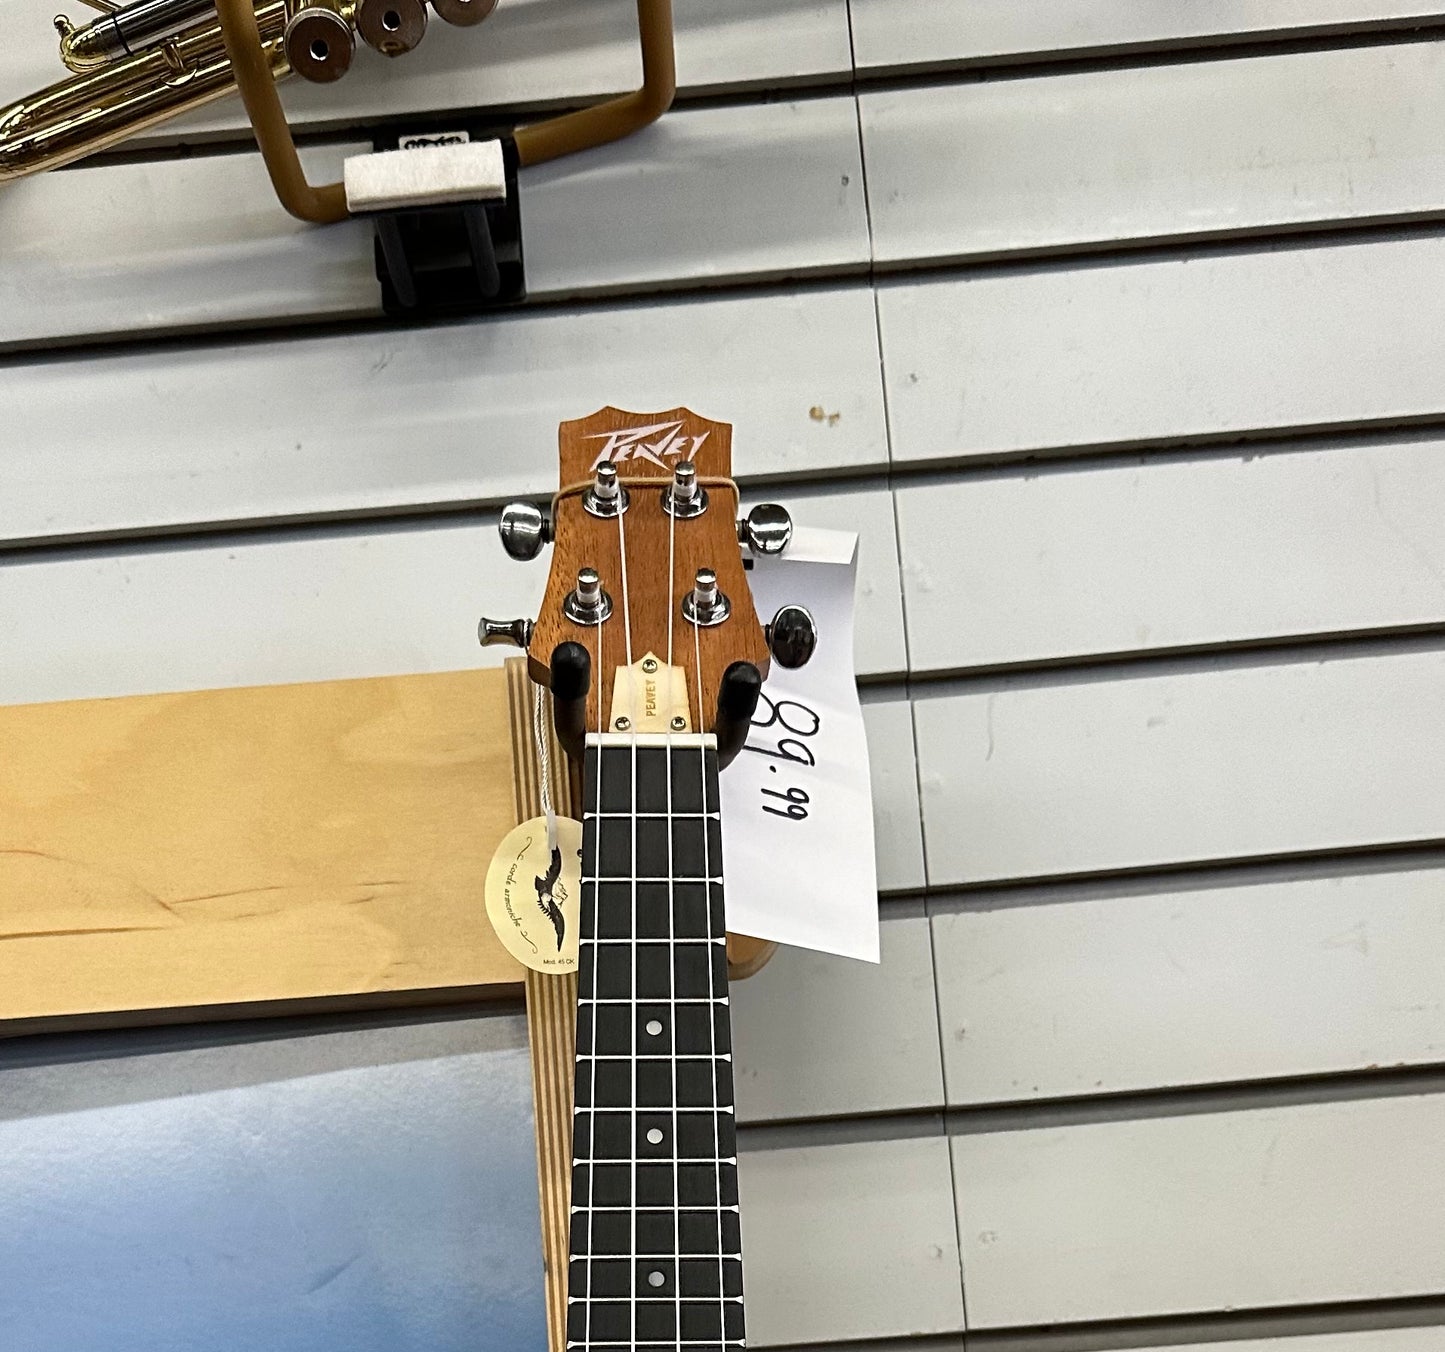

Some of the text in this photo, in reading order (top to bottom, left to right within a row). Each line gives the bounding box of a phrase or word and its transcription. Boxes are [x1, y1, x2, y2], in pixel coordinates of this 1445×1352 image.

[581, 419, 711, 473] PEAVEY
[645, 679, 656, 717] PEAVEY
[741, 690, 820, 821] 89.99
